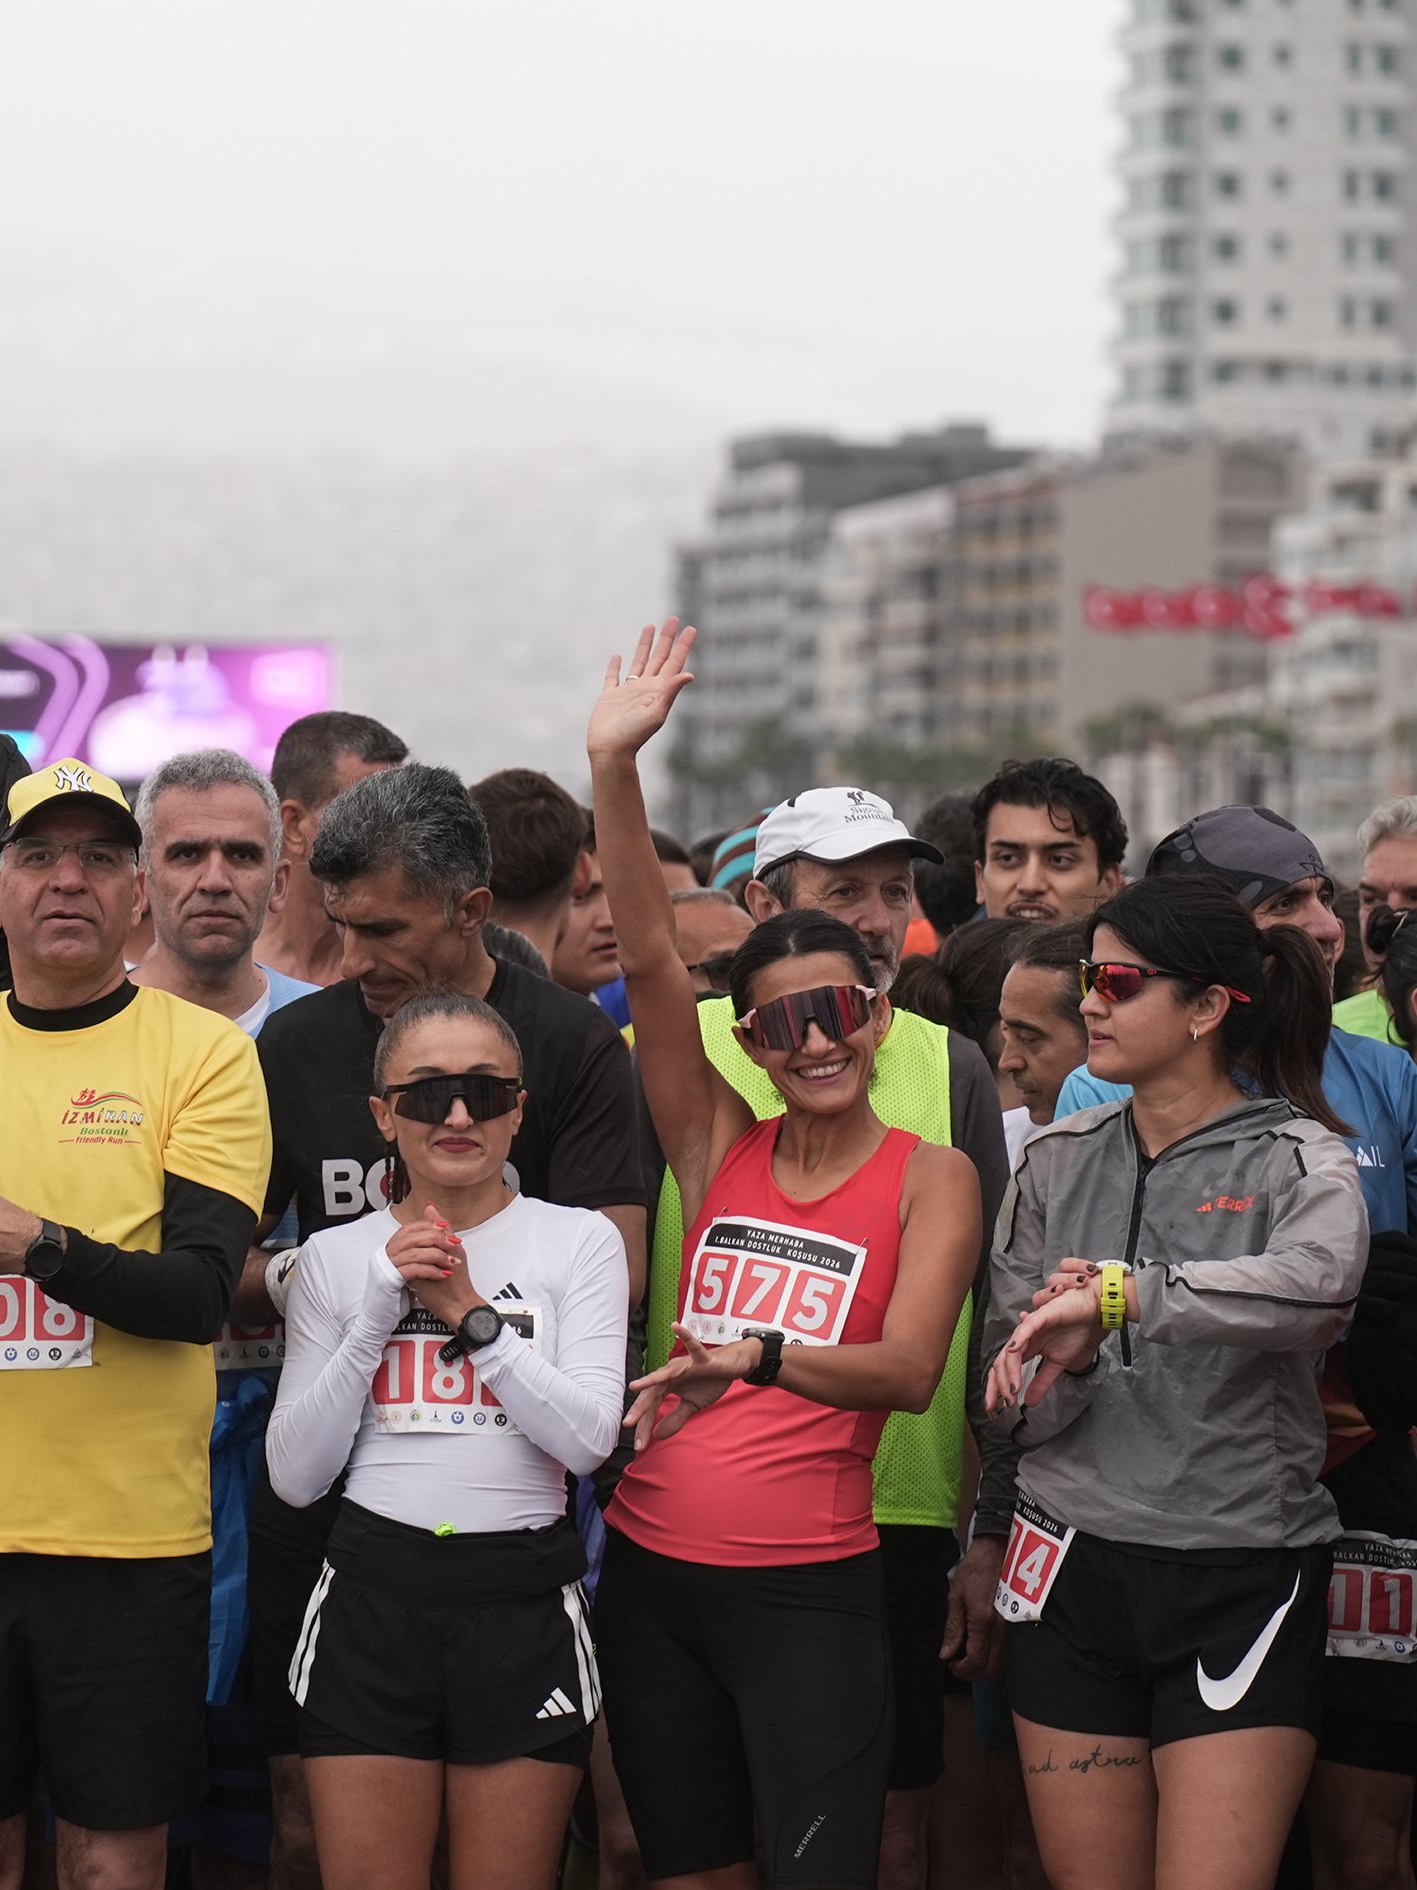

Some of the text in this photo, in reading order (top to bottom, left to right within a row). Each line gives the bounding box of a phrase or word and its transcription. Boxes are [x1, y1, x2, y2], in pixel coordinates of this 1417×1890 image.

[53, 765, 94, 792] NY
[75, 1136, 123, 1144] Friendly Run
[746, 1229, 804, 1249] YAZA MERHABA
[747, 1240, 781, 1254] DOSTLUK
[787, 1249, 818, 1263] KOŞUSU
[820, 1256, 841, 1269] 2026
[698, 1257, 835, 1331] 575
[382, 1345, 465, 1399] 18
[1042, 1518, 1058, 1533] 2026
[1329, 1573, 1400, 1630] 11
[794, 1815, 827, 1859] MERRELL
